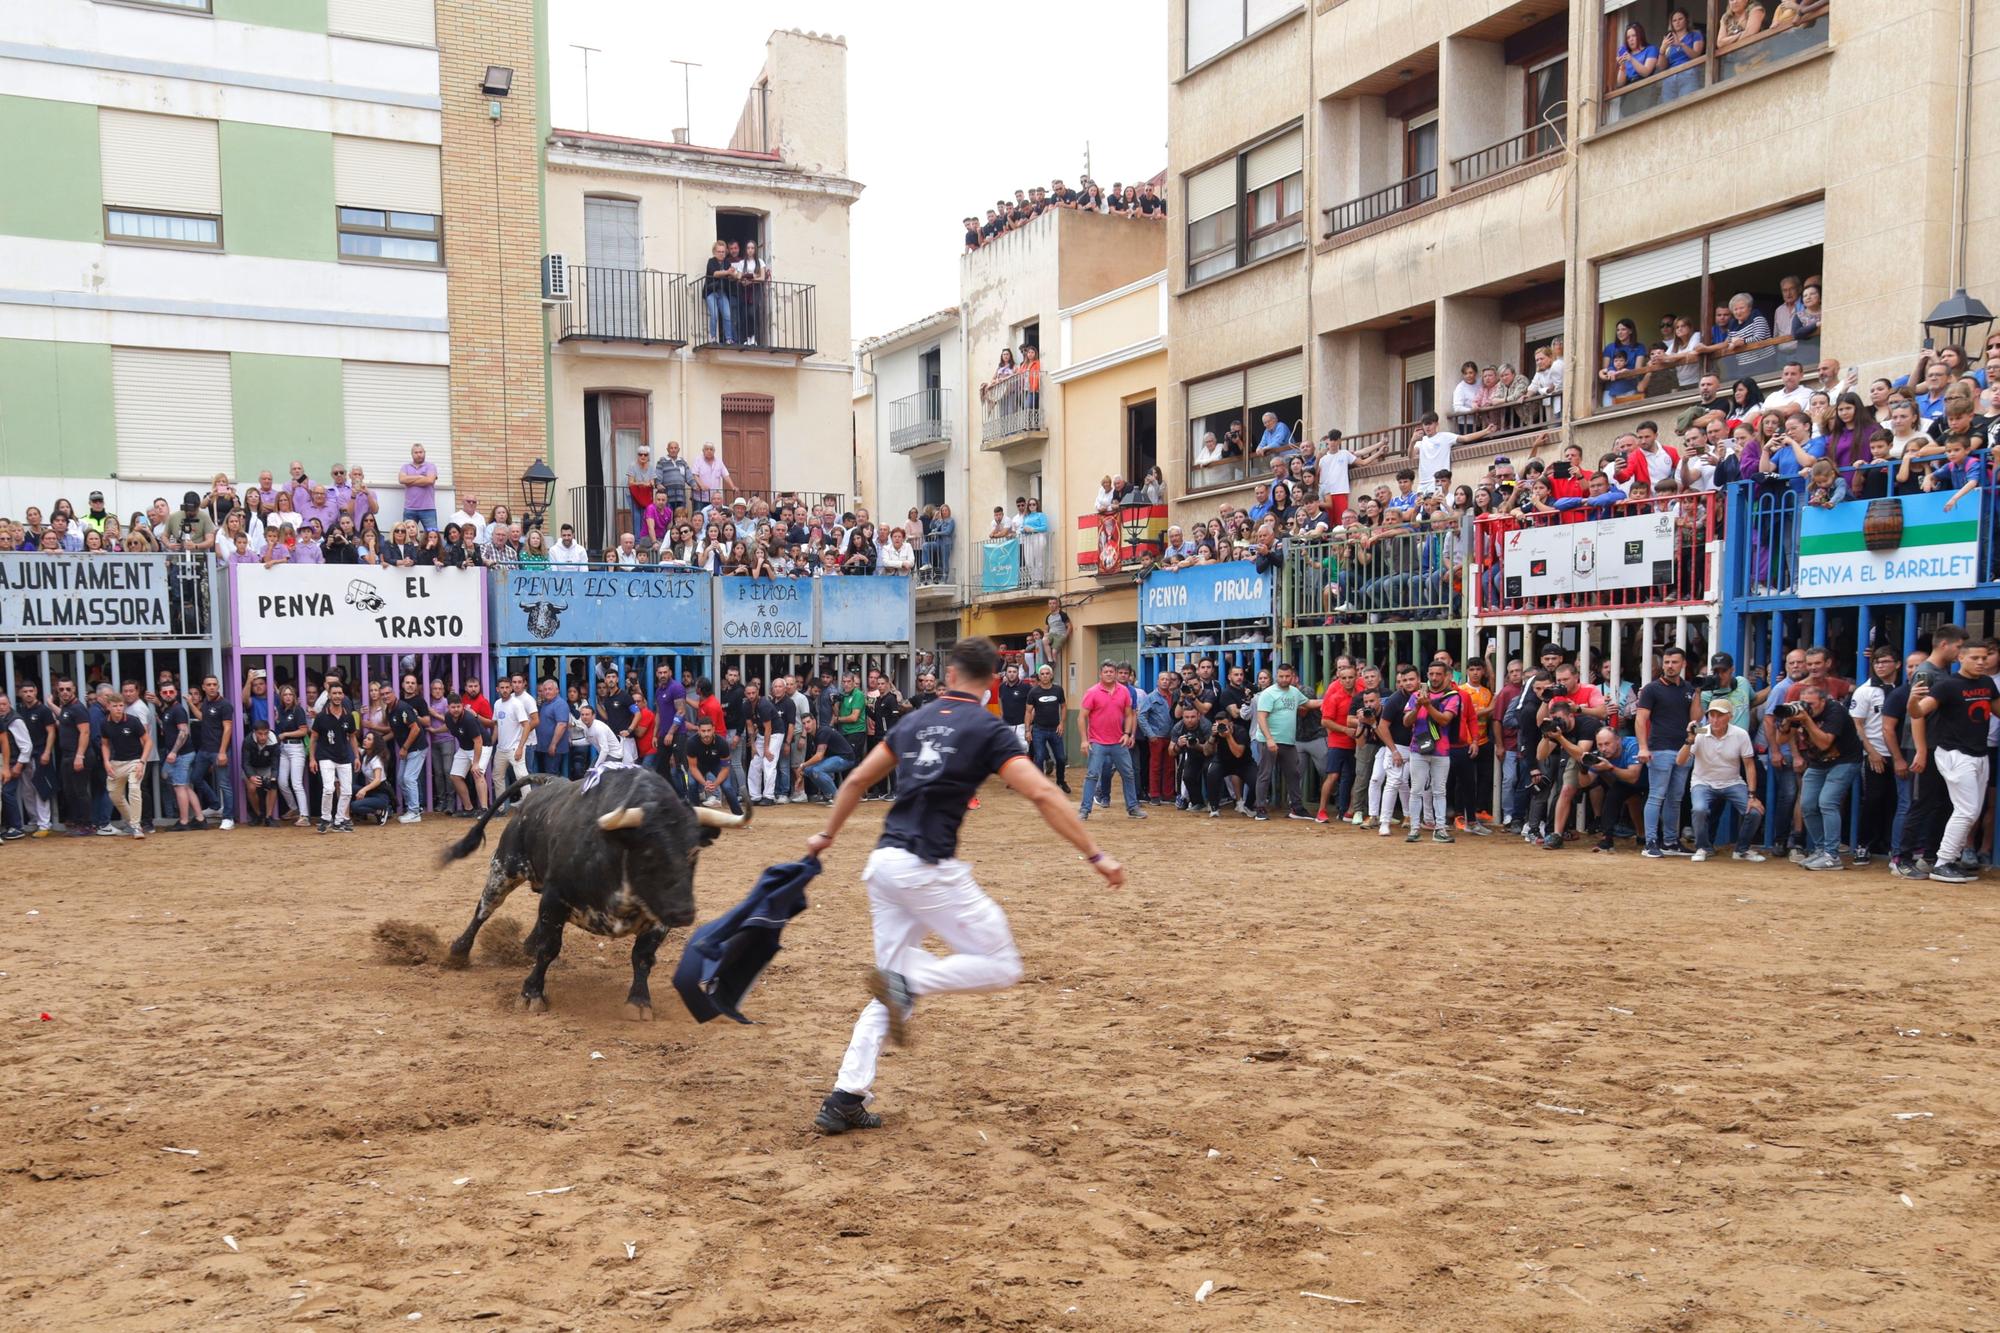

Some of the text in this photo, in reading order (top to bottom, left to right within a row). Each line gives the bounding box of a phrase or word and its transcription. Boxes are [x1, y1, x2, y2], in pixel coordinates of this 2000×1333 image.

[0, 562, 153, 590] AJUNTAMENT
[1800, 555, 1975, 586] PENYA EL BARRILET
[405, 576, 430, 598] EL
[514, 576, 574, 597] PENYA
[584, 577, 618, 597] ELS
[1149, 577, 1263, 608] PENYA PIROLA
[23, 598, 165, 626] ALMASSORA
[258, 593, 334, 618] PENYA
[375, 615, 463, 638] TRASTO
[723, 621, 808, 638] CARAGOL
